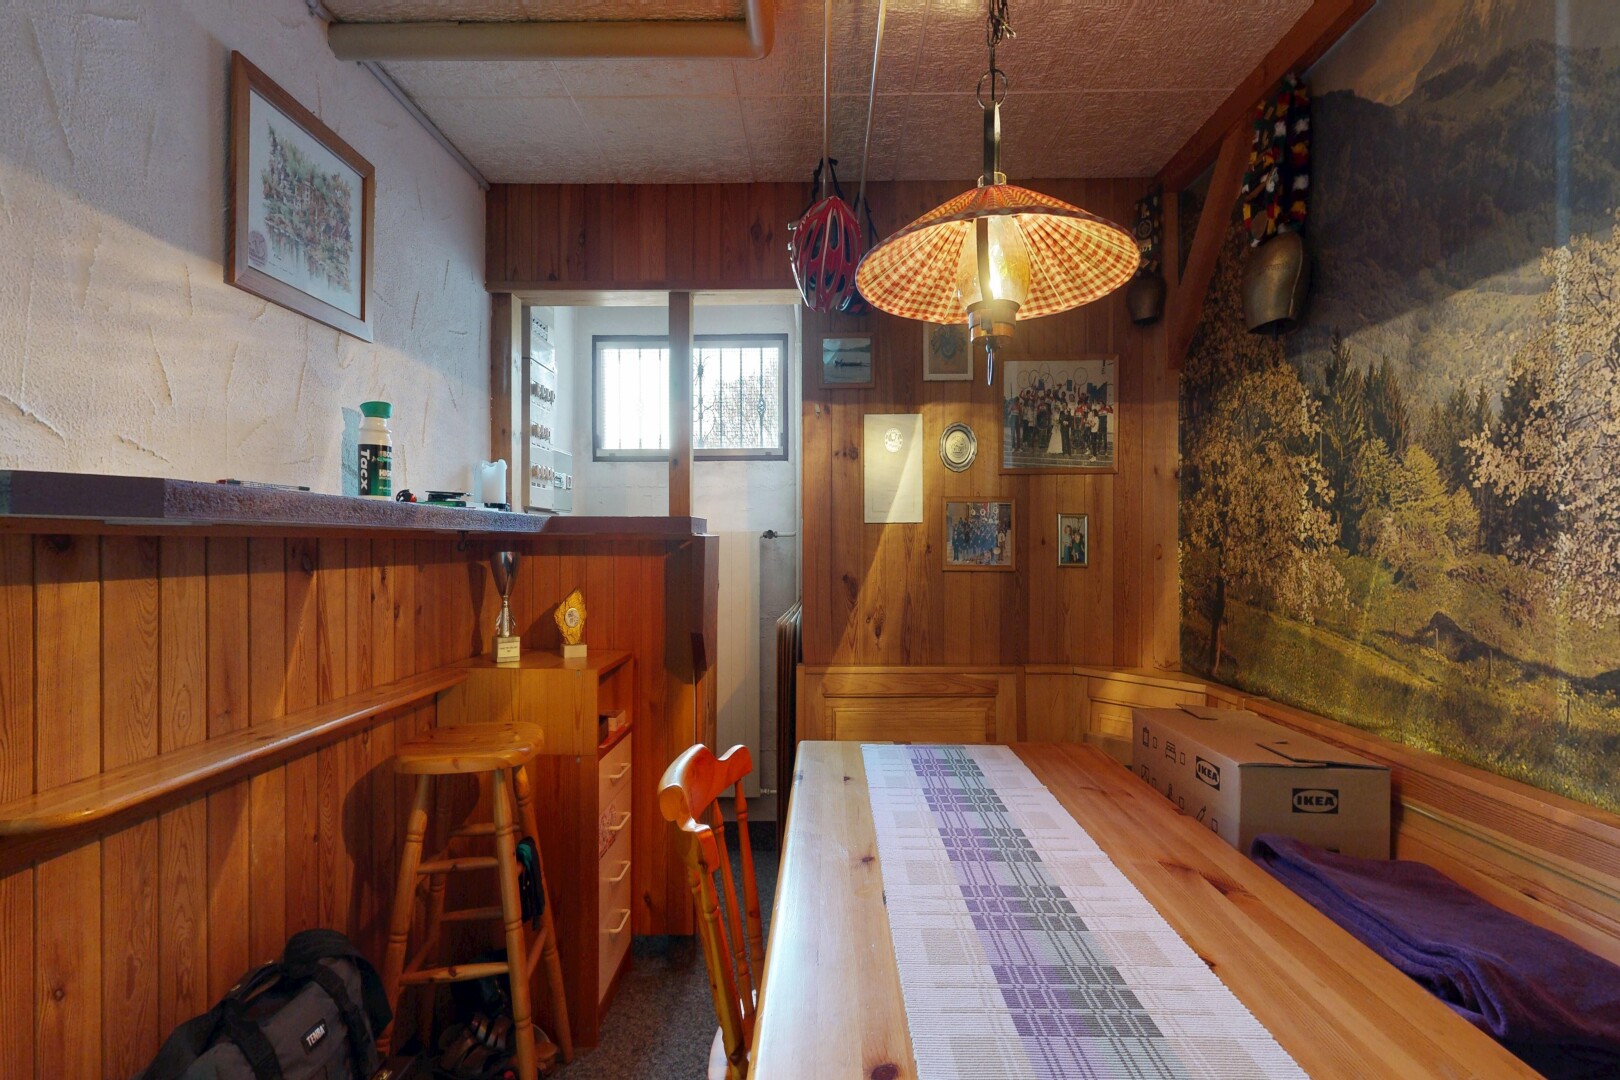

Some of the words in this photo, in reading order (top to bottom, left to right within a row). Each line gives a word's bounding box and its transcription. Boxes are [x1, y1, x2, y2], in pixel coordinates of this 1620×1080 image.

[360, 449, 371, 490] Tacx
[1197, 763, 1218, 783] IKEA
[1296, 795, 1335, 807] IKEA
